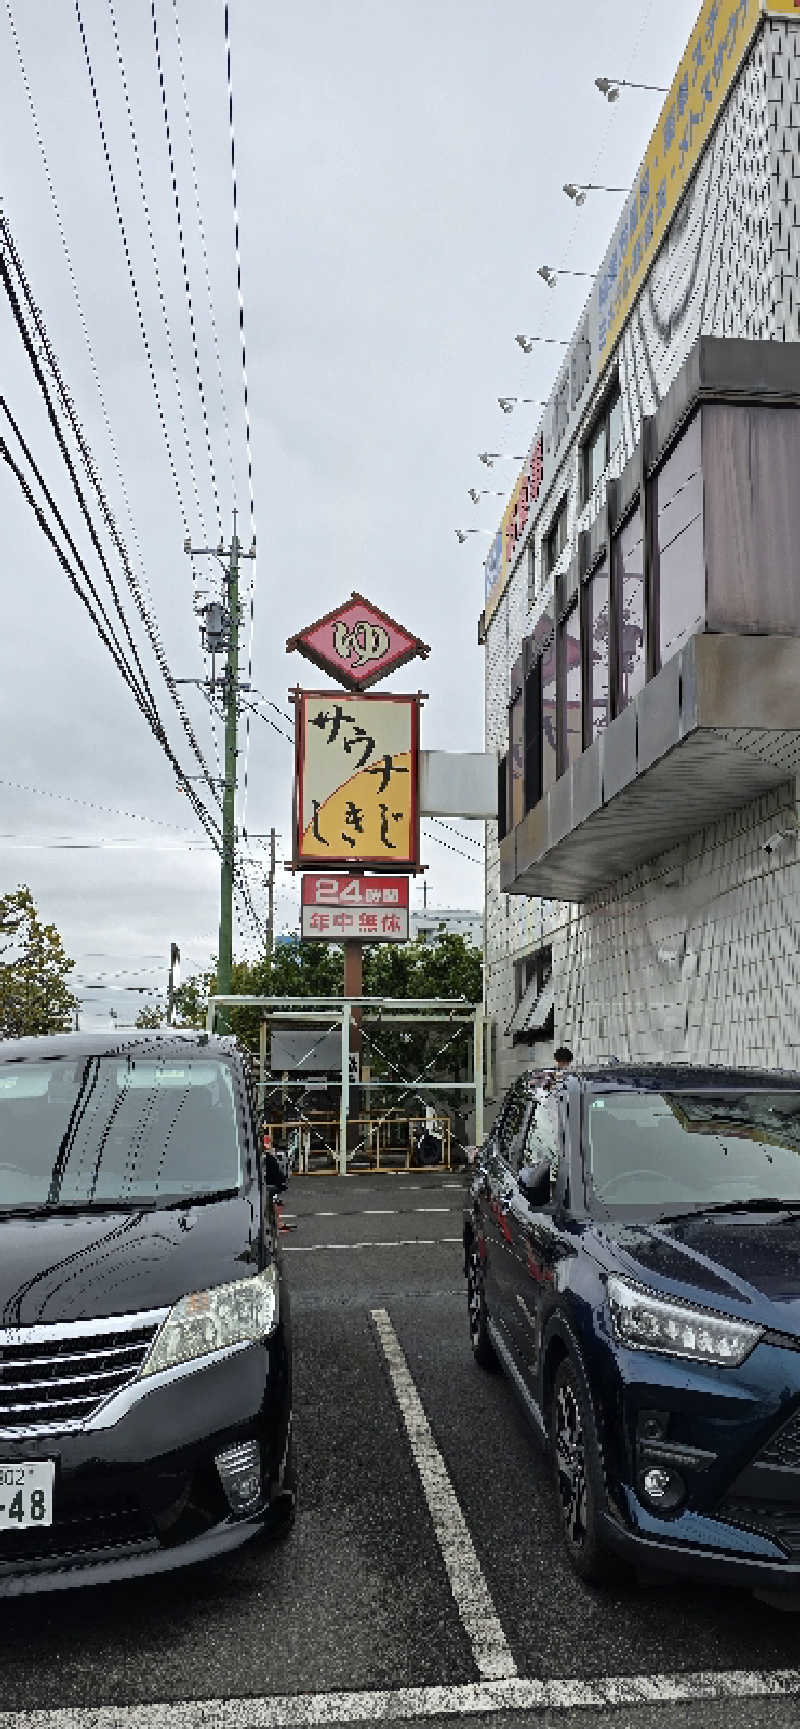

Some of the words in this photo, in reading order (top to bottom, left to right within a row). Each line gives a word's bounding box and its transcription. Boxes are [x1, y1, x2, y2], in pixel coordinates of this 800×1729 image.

[332, 621, 390, 668] ゆ
[308, 705, 408, 794] サウナ
[311, 799, 404, 848] しきじ
[310, 912, 401, 933] 年中無休
